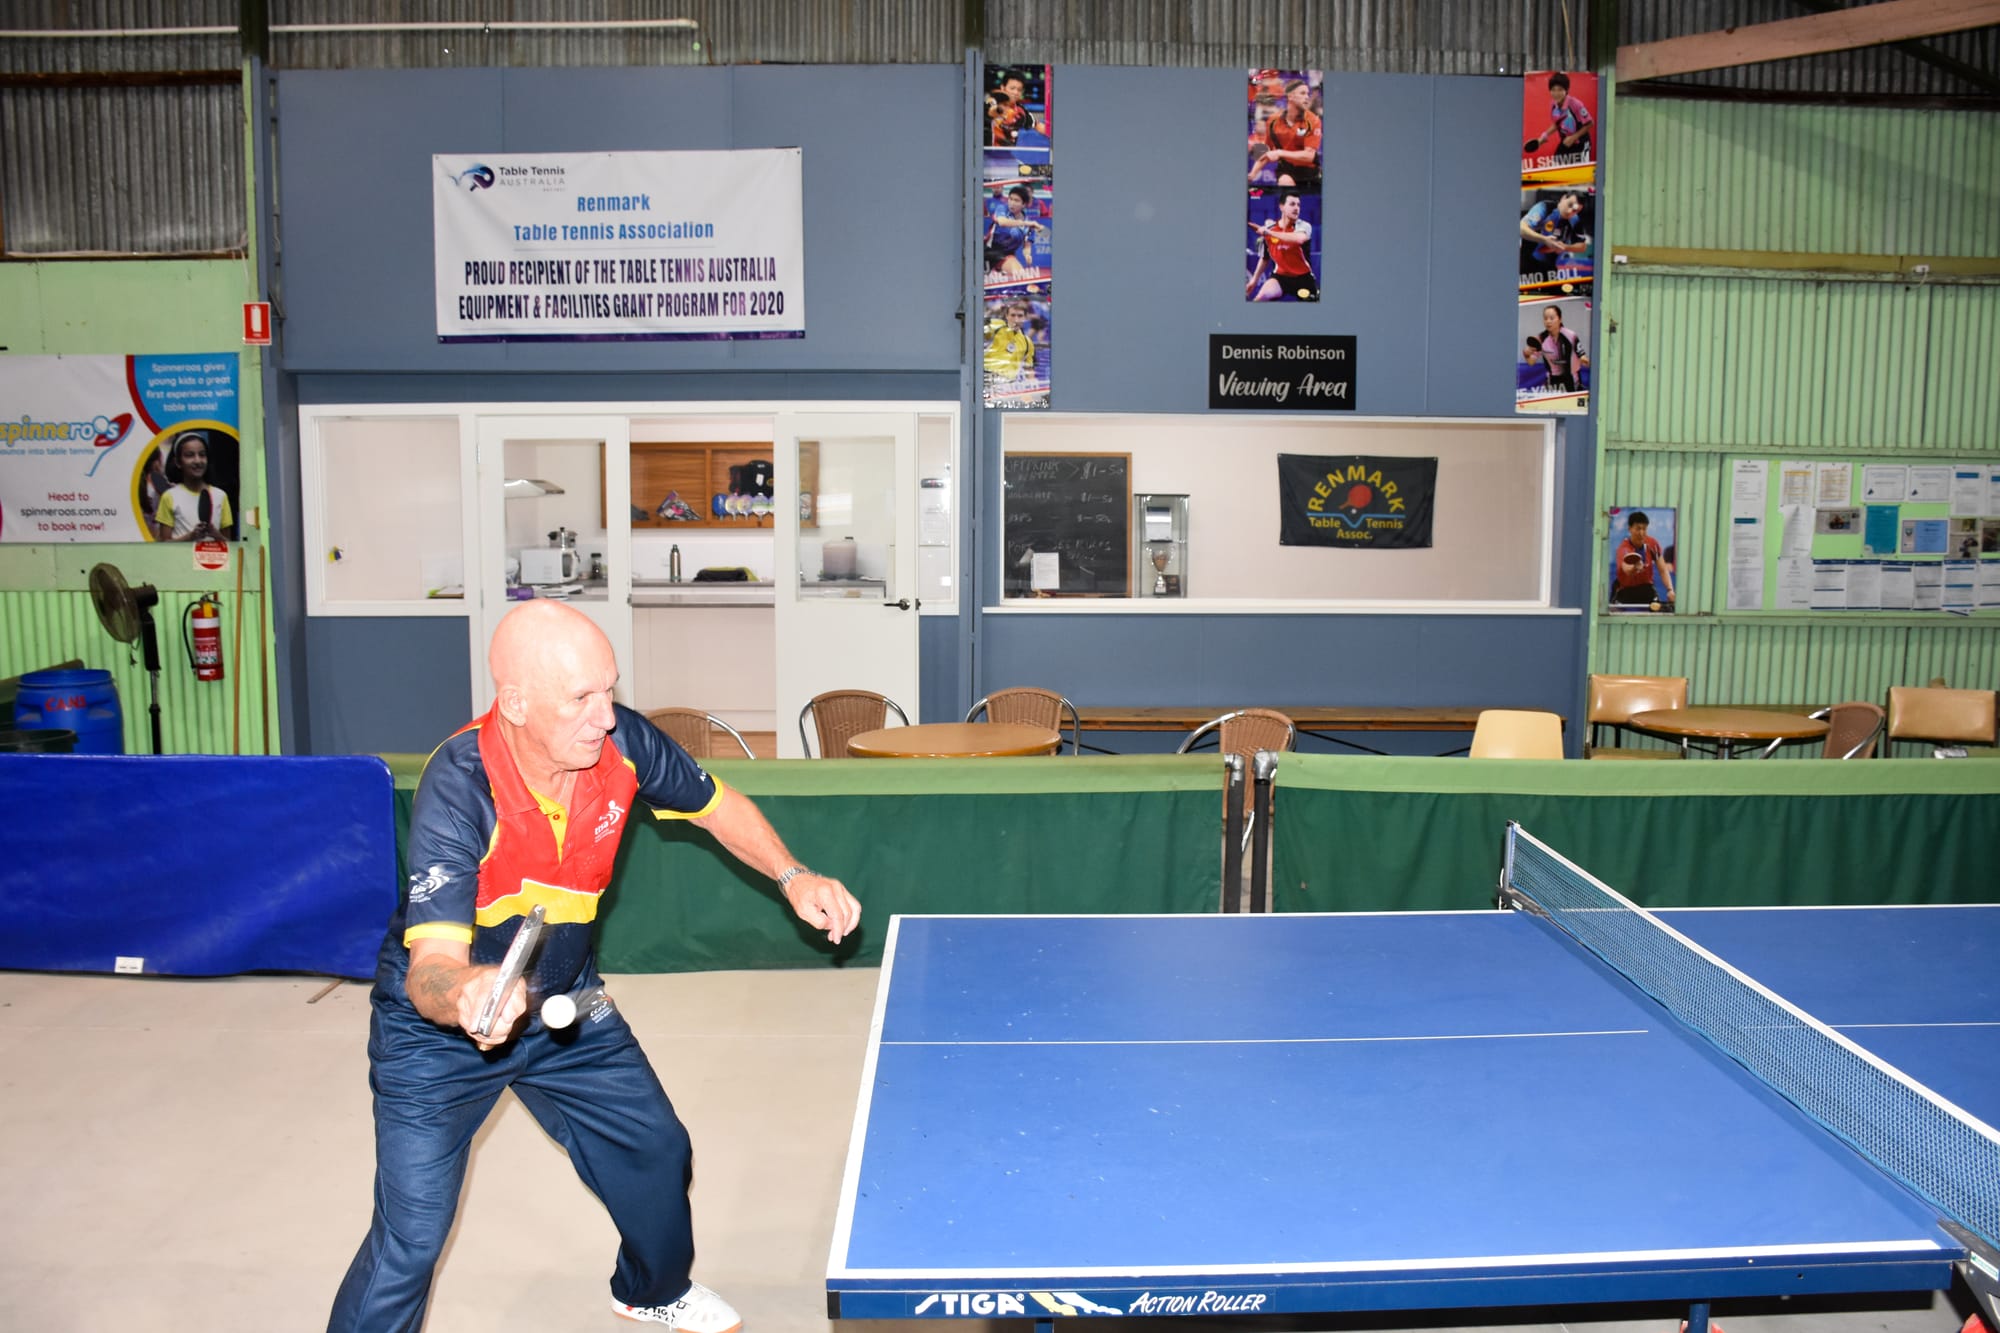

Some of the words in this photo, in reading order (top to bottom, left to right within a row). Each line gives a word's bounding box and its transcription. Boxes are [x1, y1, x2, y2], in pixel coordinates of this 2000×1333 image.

[499, 166, 528, 176] Table
[531, 165, 565, 176] Tennis
[499, 178, 565, 186] AUSTRALIA
[577, 194, 650, 212] Renmark
[514, 224, 557, 241] Table
[562, 223, 614, 240] Tennis
[619, 221, 714, 240] Association
[465, 260, 505, 285] PROUD
[510, 260, 571, 285] RECIPIENT
[575, 260, 590, 284] OF
[594, 260, 616, 284] THE
[620, 259, 657, 283] TABLE
[660, 258, 705, 283] TENNIS
[709, 257, 776, 282] AUSTRALIA
[1547, 267, 1582, 281] BOLL
[459, 294, 529, 320] EQUIPMENT
[533, 295, 541, 318] &
[545, 294, 611, 318] FACILITIES
[613, 293, 653, 317] GRANT
[657, 292, 719, 317] PROGRAM
[723, 292, 746, 316] FOR
[750, 291, 784, 315] 2020
[1222, 345, 1273, 359] Dennis
[1278, 345, 1346, 360] Robinson
[152, 363, 201, 373] Spinneroos
[203, 363, 226, 373] gives
[148, 378, 176, 388] young
[178, 376, 196, 385] kids
[206, 376, 231, 386] great
[1219, 371, 1291, 402] Viewing
[1296, 373, 1348, 399] Area
[146, 389, 164, 398] first
[166, 390, 213, 399] experience
[216, 389, 234, 397] with
[163, 403, 185, 412] table
[0, 414, 120, 447] spinneroos
[1307, 465, 1406, 513] RENMARK
[48, 492, 75, 501] Head
[79, 493, 89, 501] to
[20, 507, 117, 518] spinneroos.com.au
[38, 523, 49, 531] to
[51, 521, 76, 531] book
[79, 522, 105, 531] now!
[1309, 517, 1341, 528] Table
[1366, 518, 1403, 529] Tennis
[1337, 529, 1374, 540] Assoc.
[45, 695, 87, 712] CANS
[1129, 1291, 1198, 1313] ACTION
[1196, 1291, 1267, 1312] ROLLER
